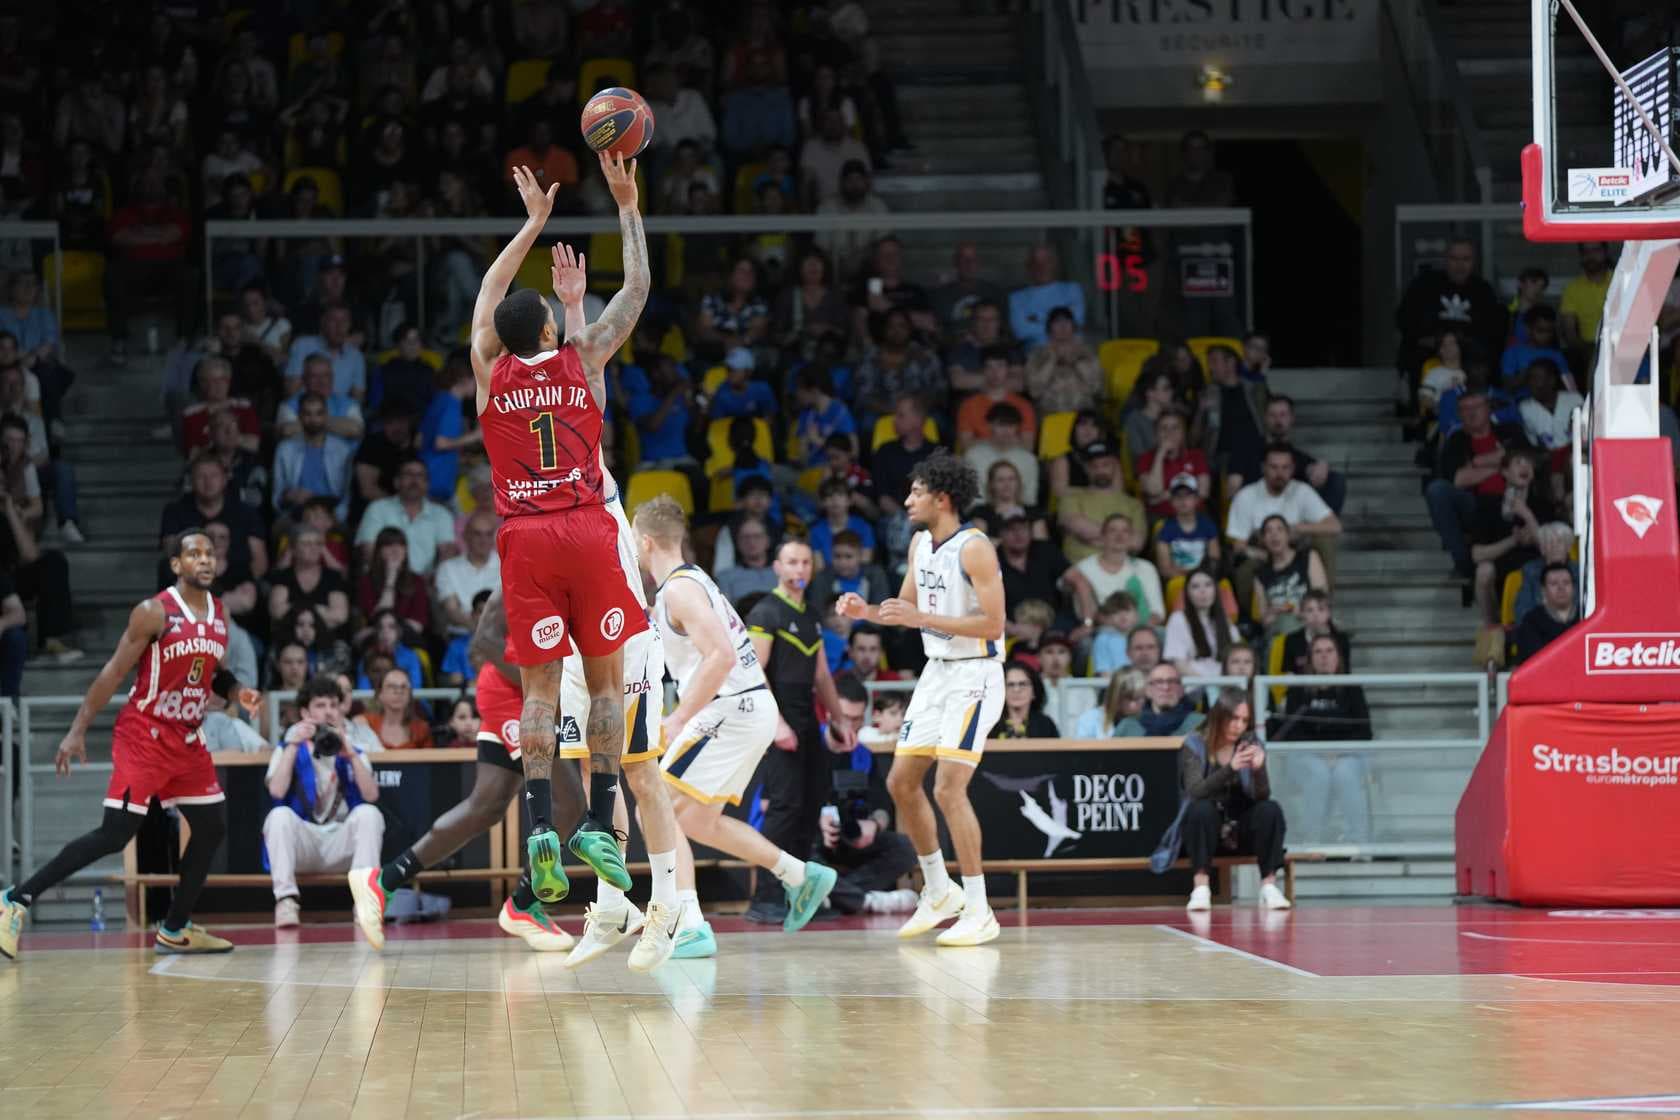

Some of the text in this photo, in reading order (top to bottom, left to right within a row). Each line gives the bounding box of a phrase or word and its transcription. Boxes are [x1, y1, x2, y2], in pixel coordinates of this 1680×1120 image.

[1600, 188, 1628, 197] ELITE
[493, 385, 563, 415] CAUPAIN
[529, 411, 557, 471] 1
[506, 467, 582, 491] LUNETS
[919, 569, 947, 592] JDA
[536, 622, 560, 639] TOP
[538, 631, 561, 645] music
[187, 656, 206, 686] 5
[624, 680, 651, 695] JDA
[738, 697, 755, 713] 43
[1532, 743, 1680, 774] Strasbour
[1072, 773, 1145, 803] DECO
[1076, 802, 1144, 832] PEINT
